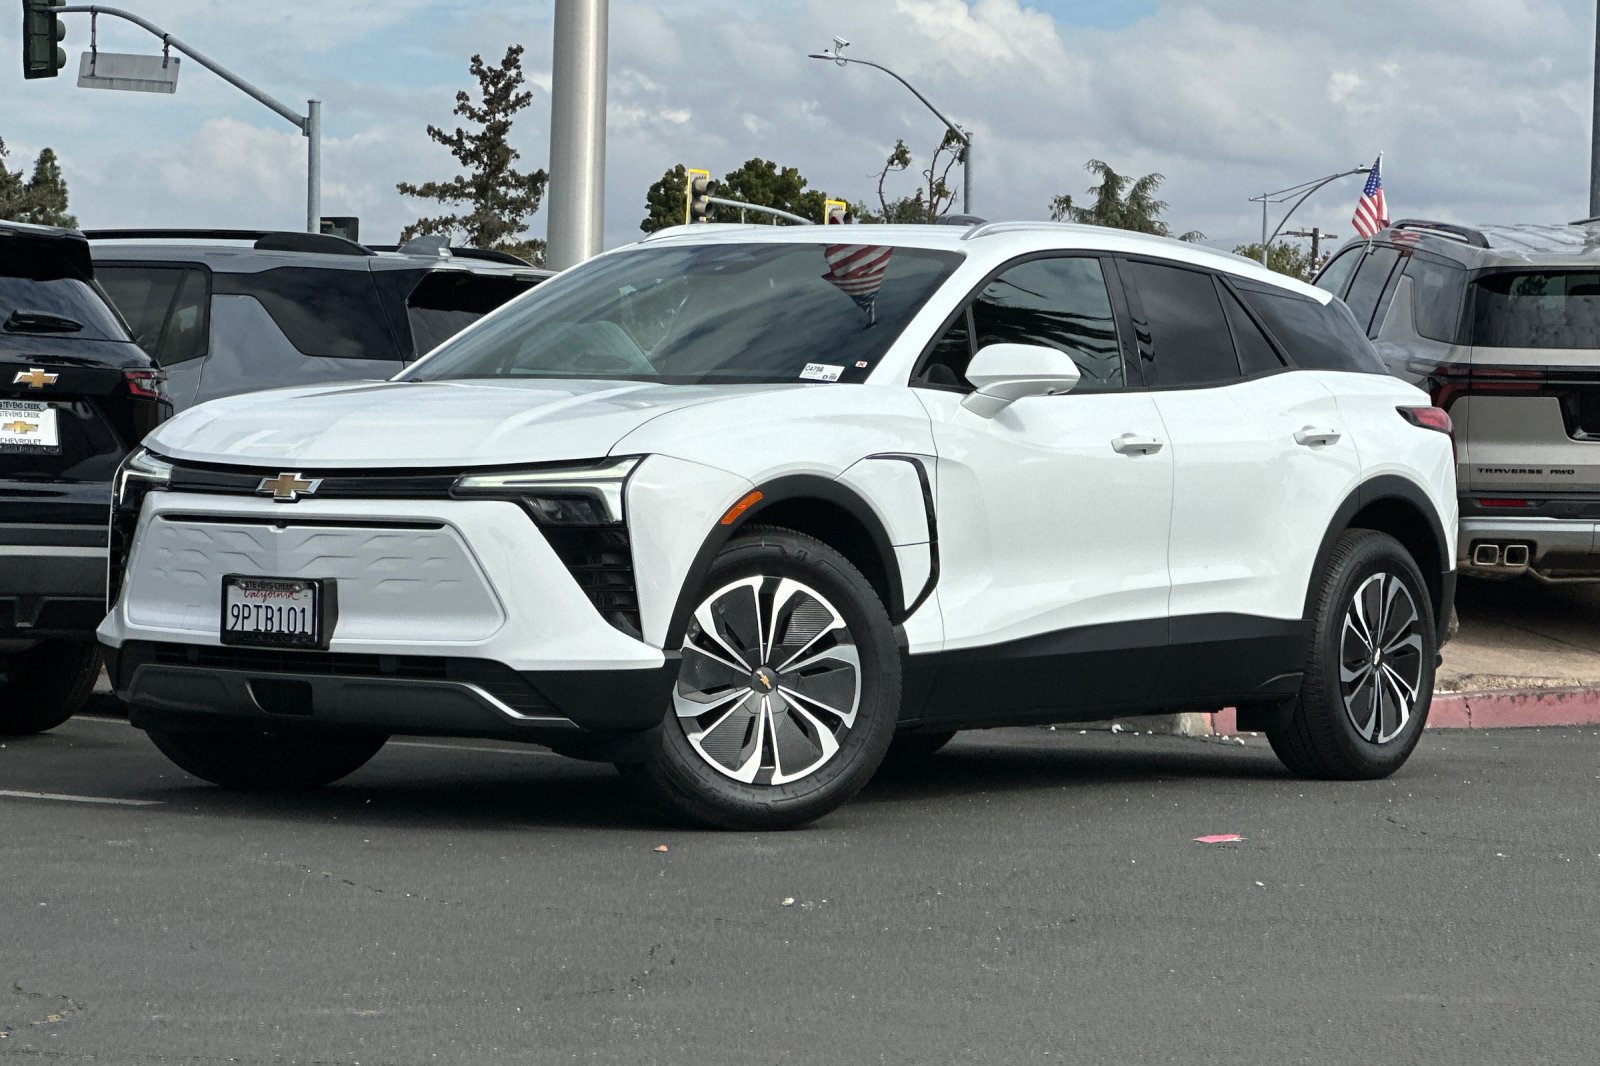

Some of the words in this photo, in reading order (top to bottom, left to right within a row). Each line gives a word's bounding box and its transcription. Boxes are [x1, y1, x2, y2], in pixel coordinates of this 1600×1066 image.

[0, 437, 42, 446] CHEVROLET
[245, 581, 273, 589] STEVENS
[231, 604, 308, 635] 9PIB101
